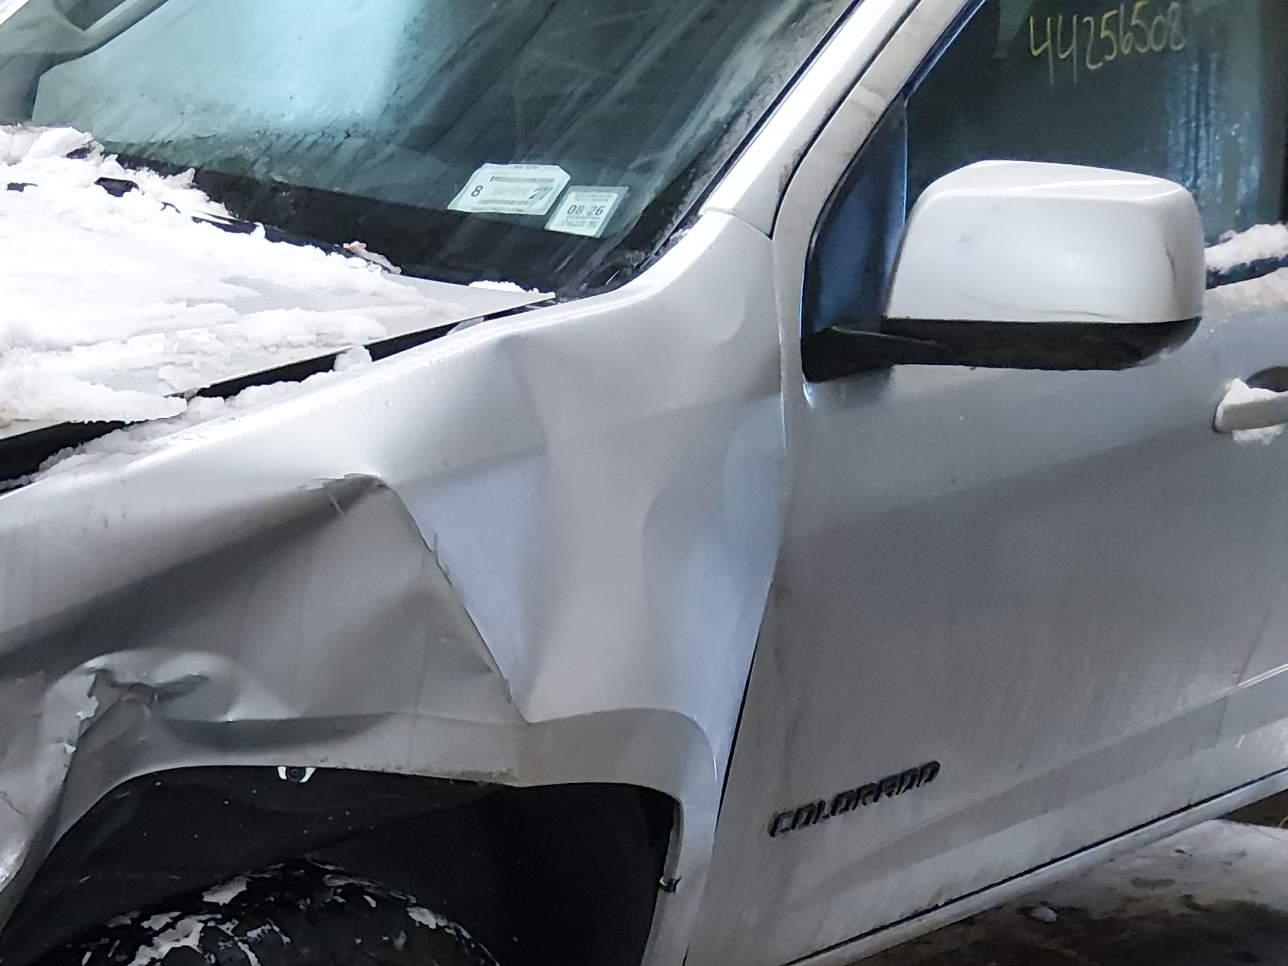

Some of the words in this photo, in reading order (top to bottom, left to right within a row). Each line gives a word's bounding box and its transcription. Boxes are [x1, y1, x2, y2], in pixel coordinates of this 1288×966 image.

[1029, 1, 1186, 85] 44256508
[470, 184, 484, 198] 8
[566, 204, 585, 216] 08
[586, 205, 607, 217] 26
[767, 760, 941, 838] COLORADO
